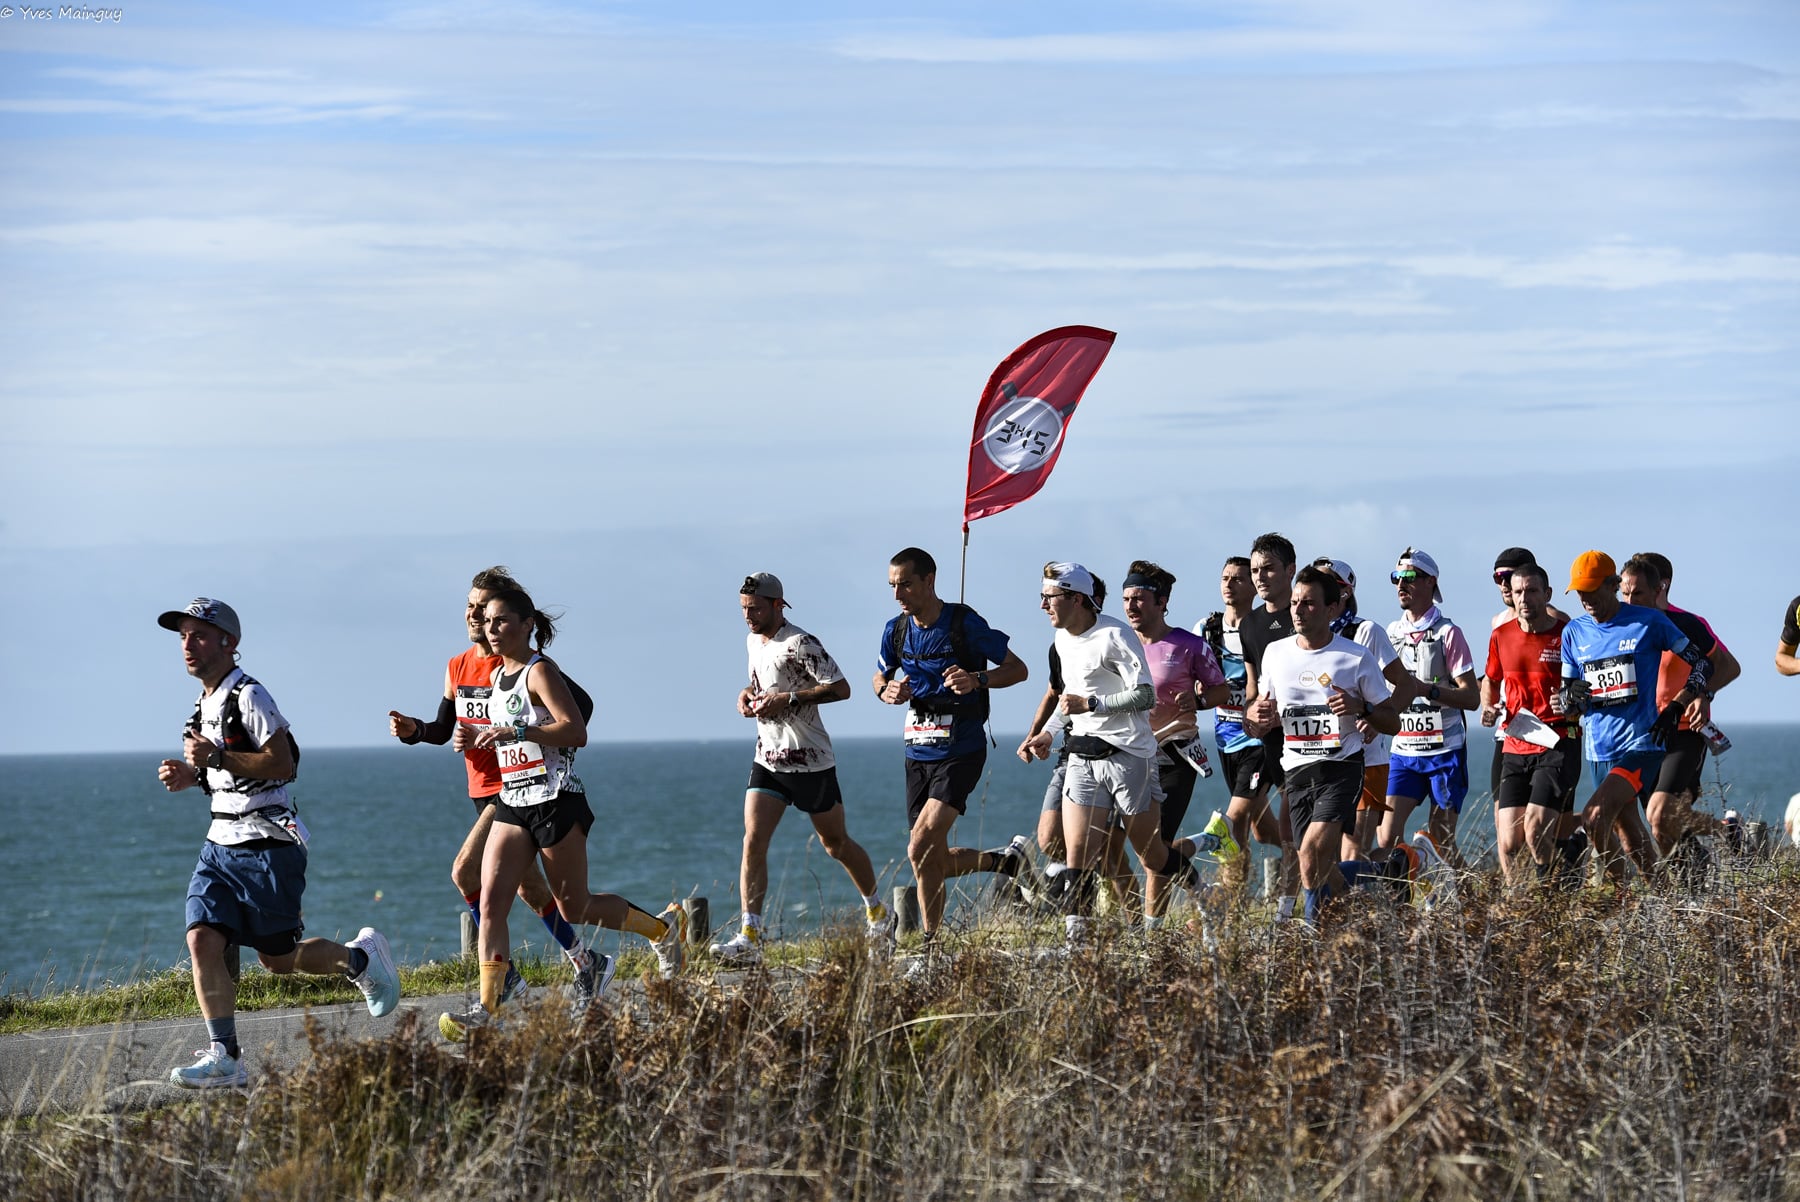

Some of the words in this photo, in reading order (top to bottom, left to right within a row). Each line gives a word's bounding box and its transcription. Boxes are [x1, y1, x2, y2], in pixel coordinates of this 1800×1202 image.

[1598, 670, 1623, 688] 850
[1291, 719, 1331, 736] 1175
[1400, 717, 1434, 732] 1065
[502, 747, 528, 767] 786
